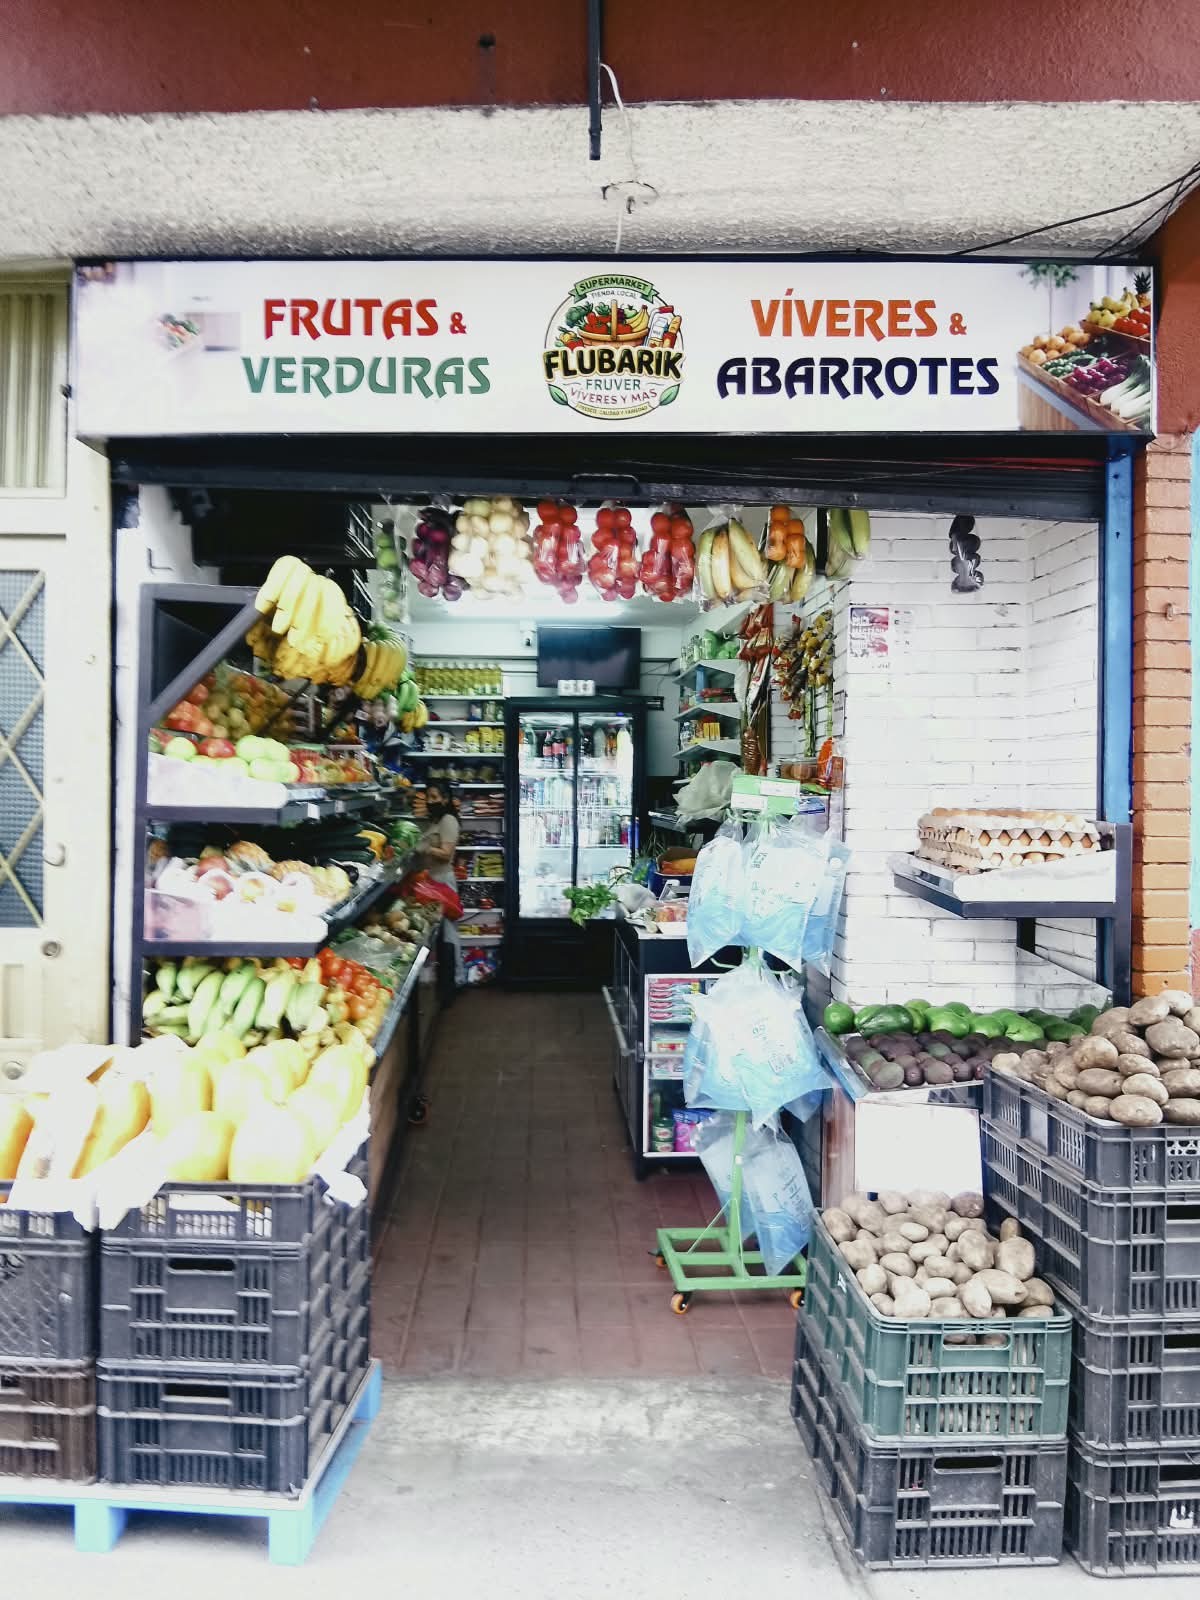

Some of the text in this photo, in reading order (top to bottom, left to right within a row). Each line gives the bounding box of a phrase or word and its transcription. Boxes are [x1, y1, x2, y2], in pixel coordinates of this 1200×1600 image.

[579, 277, 649, 292] SUPERMARKET
[592, 290, 637, 299] TIENDA LOCAL
[264, 299, 467, 341] FRUTAS &
[751, 288, 967, 342] VÍVERES &
[241, 357, 491, 399] VERDURAS
[543, 348, 684, 380] FLUBARIK
[716, 357, 1000, 400] ABARROTES
[586, 379, 641, 391] FRUVER
[620, 395, 628, 404] Y
